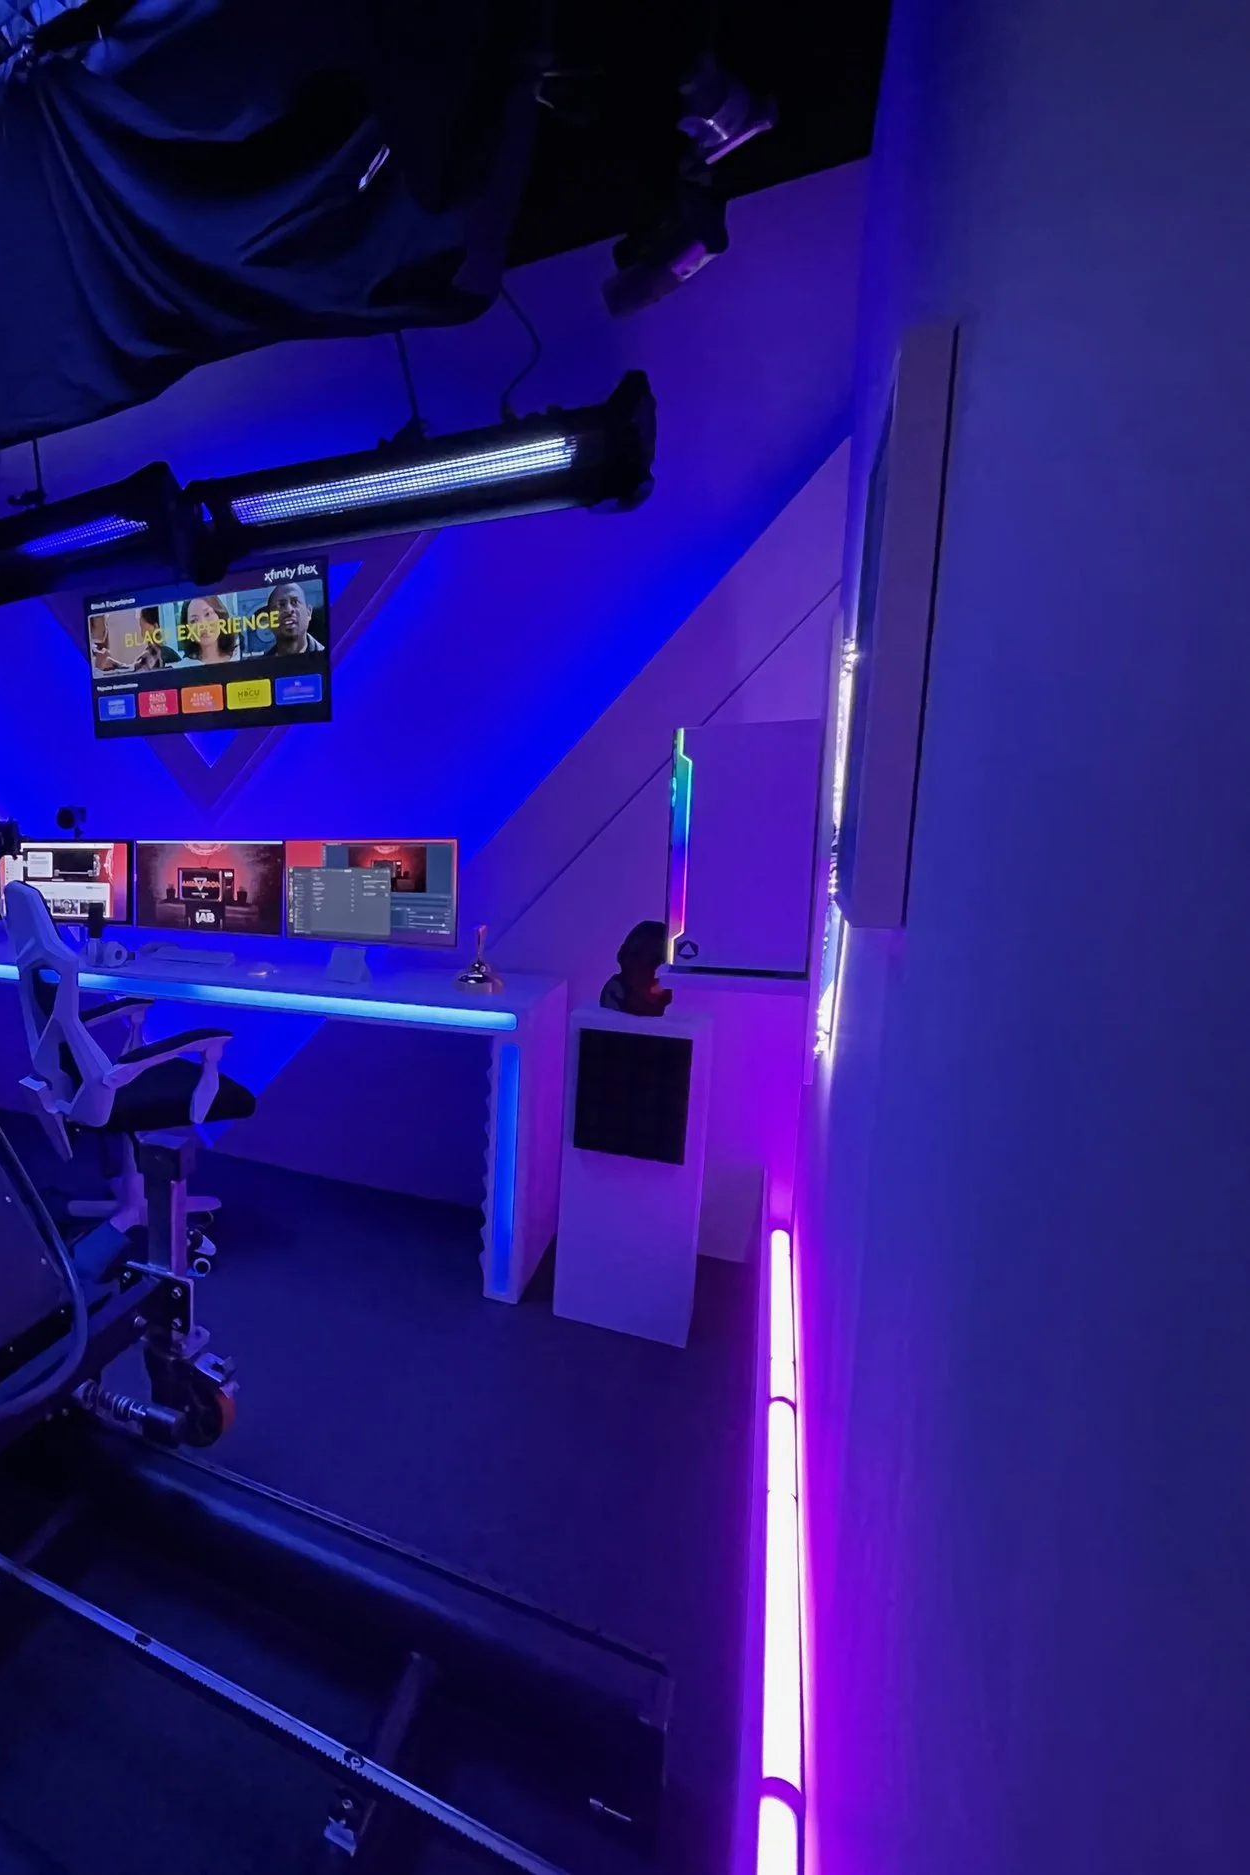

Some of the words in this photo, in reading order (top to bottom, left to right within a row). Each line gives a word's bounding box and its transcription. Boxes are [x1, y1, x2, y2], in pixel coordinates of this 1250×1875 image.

[264, 565, 296, 583] xfinity
[297, 563, 318, 576] flex
[124, 625, 171, 648] BLAC
[177, 610, 280, 642] EXPERIENCE
